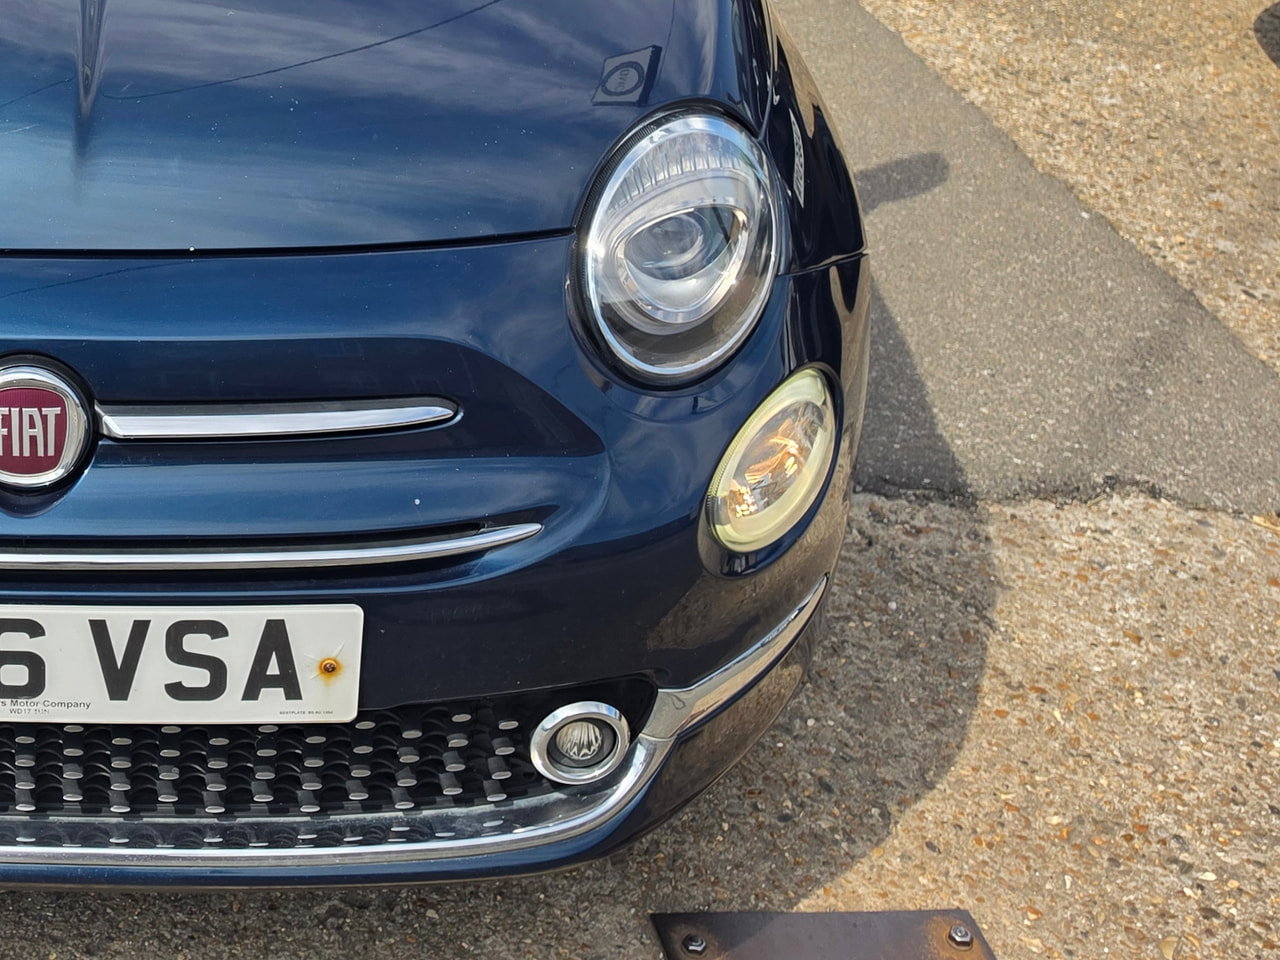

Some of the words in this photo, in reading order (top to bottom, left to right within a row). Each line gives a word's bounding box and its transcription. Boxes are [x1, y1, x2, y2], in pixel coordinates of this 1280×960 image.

[88, 618, 303, 701] VSA
[10, 699, 40, 707] Motor
[43, 700, 91, 709] Company
